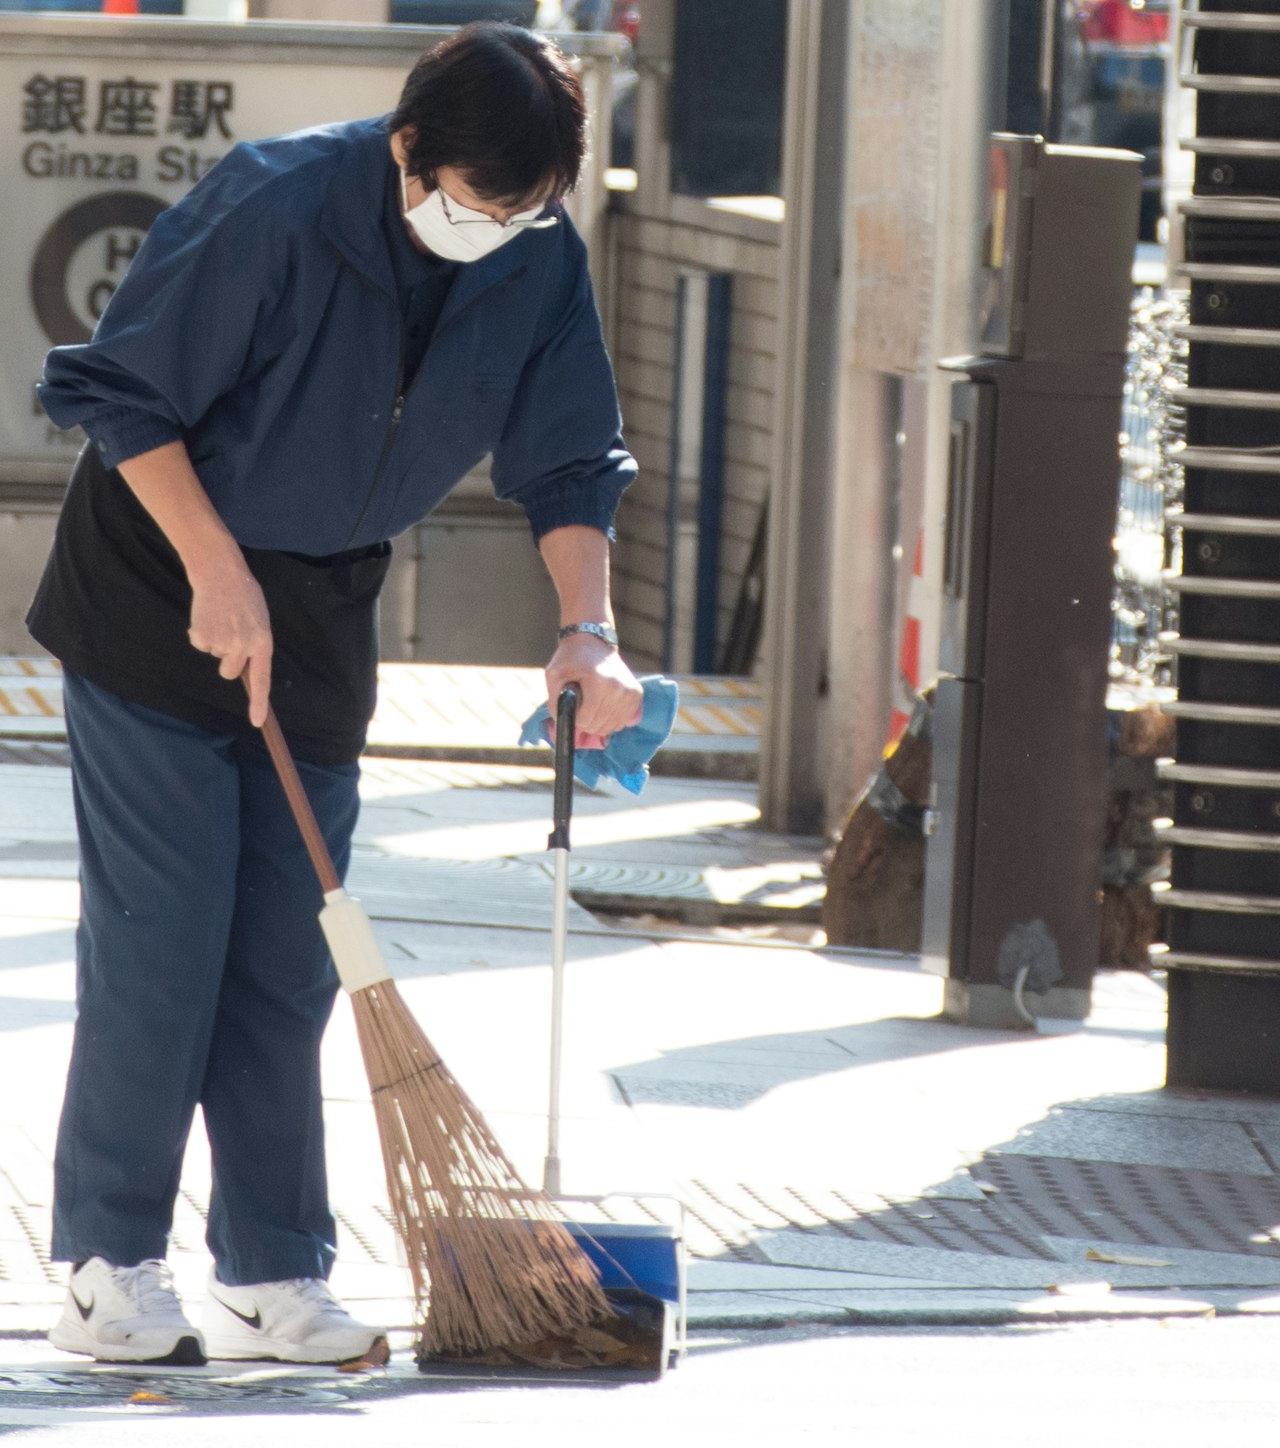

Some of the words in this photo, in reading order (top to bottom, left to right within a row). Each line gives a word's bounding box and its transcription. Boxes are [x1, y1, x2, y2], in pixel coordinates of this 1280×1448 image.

[22, 73, 234, 139] 銀座駅
[22, 142, 139, 179] Ginza
